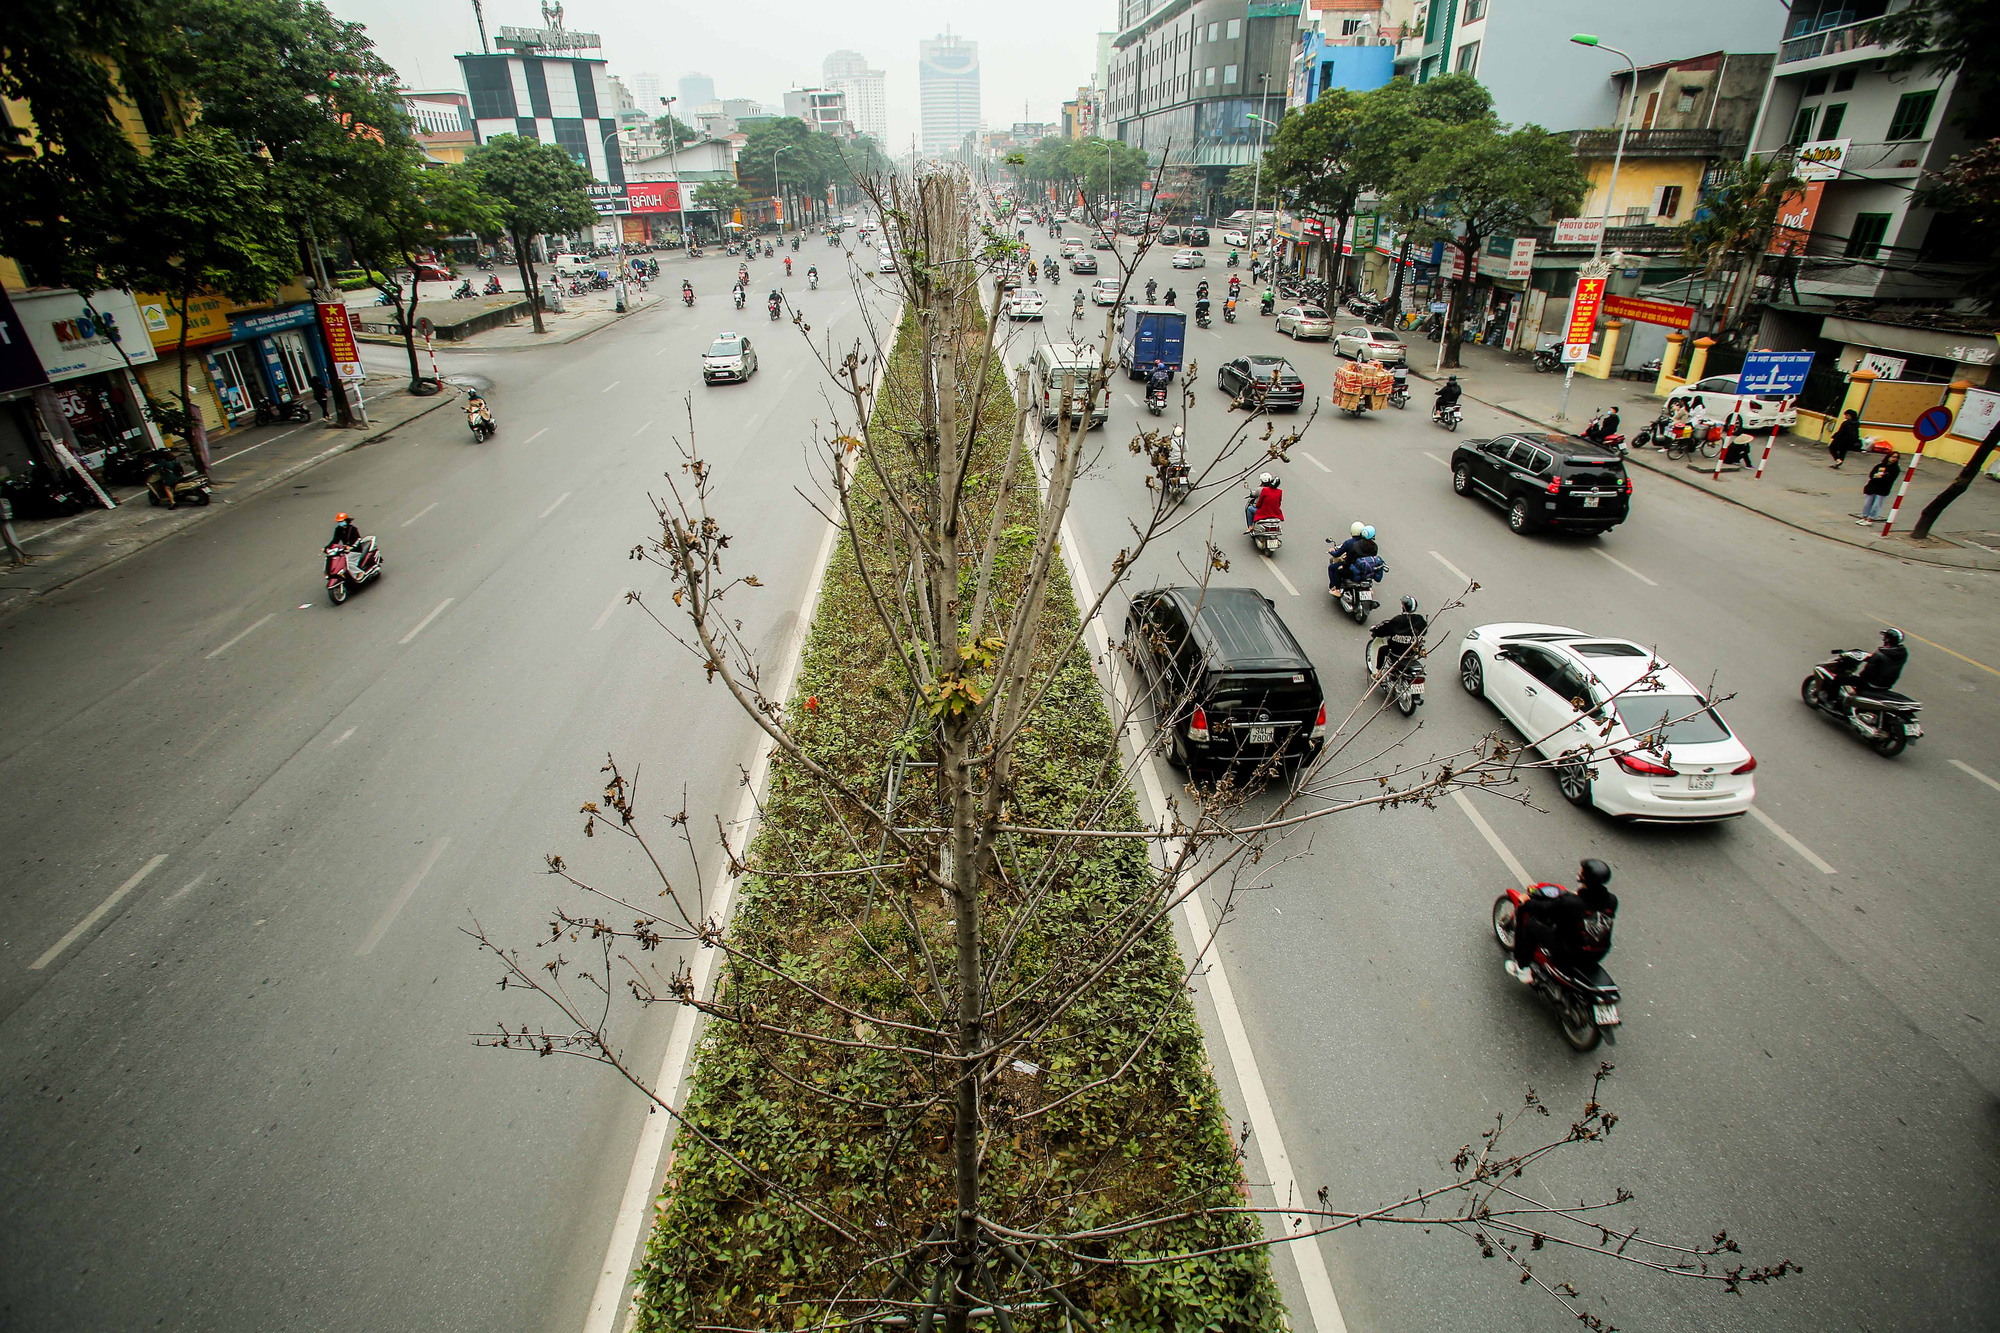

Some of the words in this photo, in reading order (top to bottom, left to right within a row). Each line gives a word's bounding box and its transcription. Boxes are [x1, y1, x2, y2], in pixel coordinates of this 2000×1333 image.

[585, 184, 593, 194] TẾ
[594, 184, 606, 195] VIỆT
[631, 192, 662, 207] BÁNH
